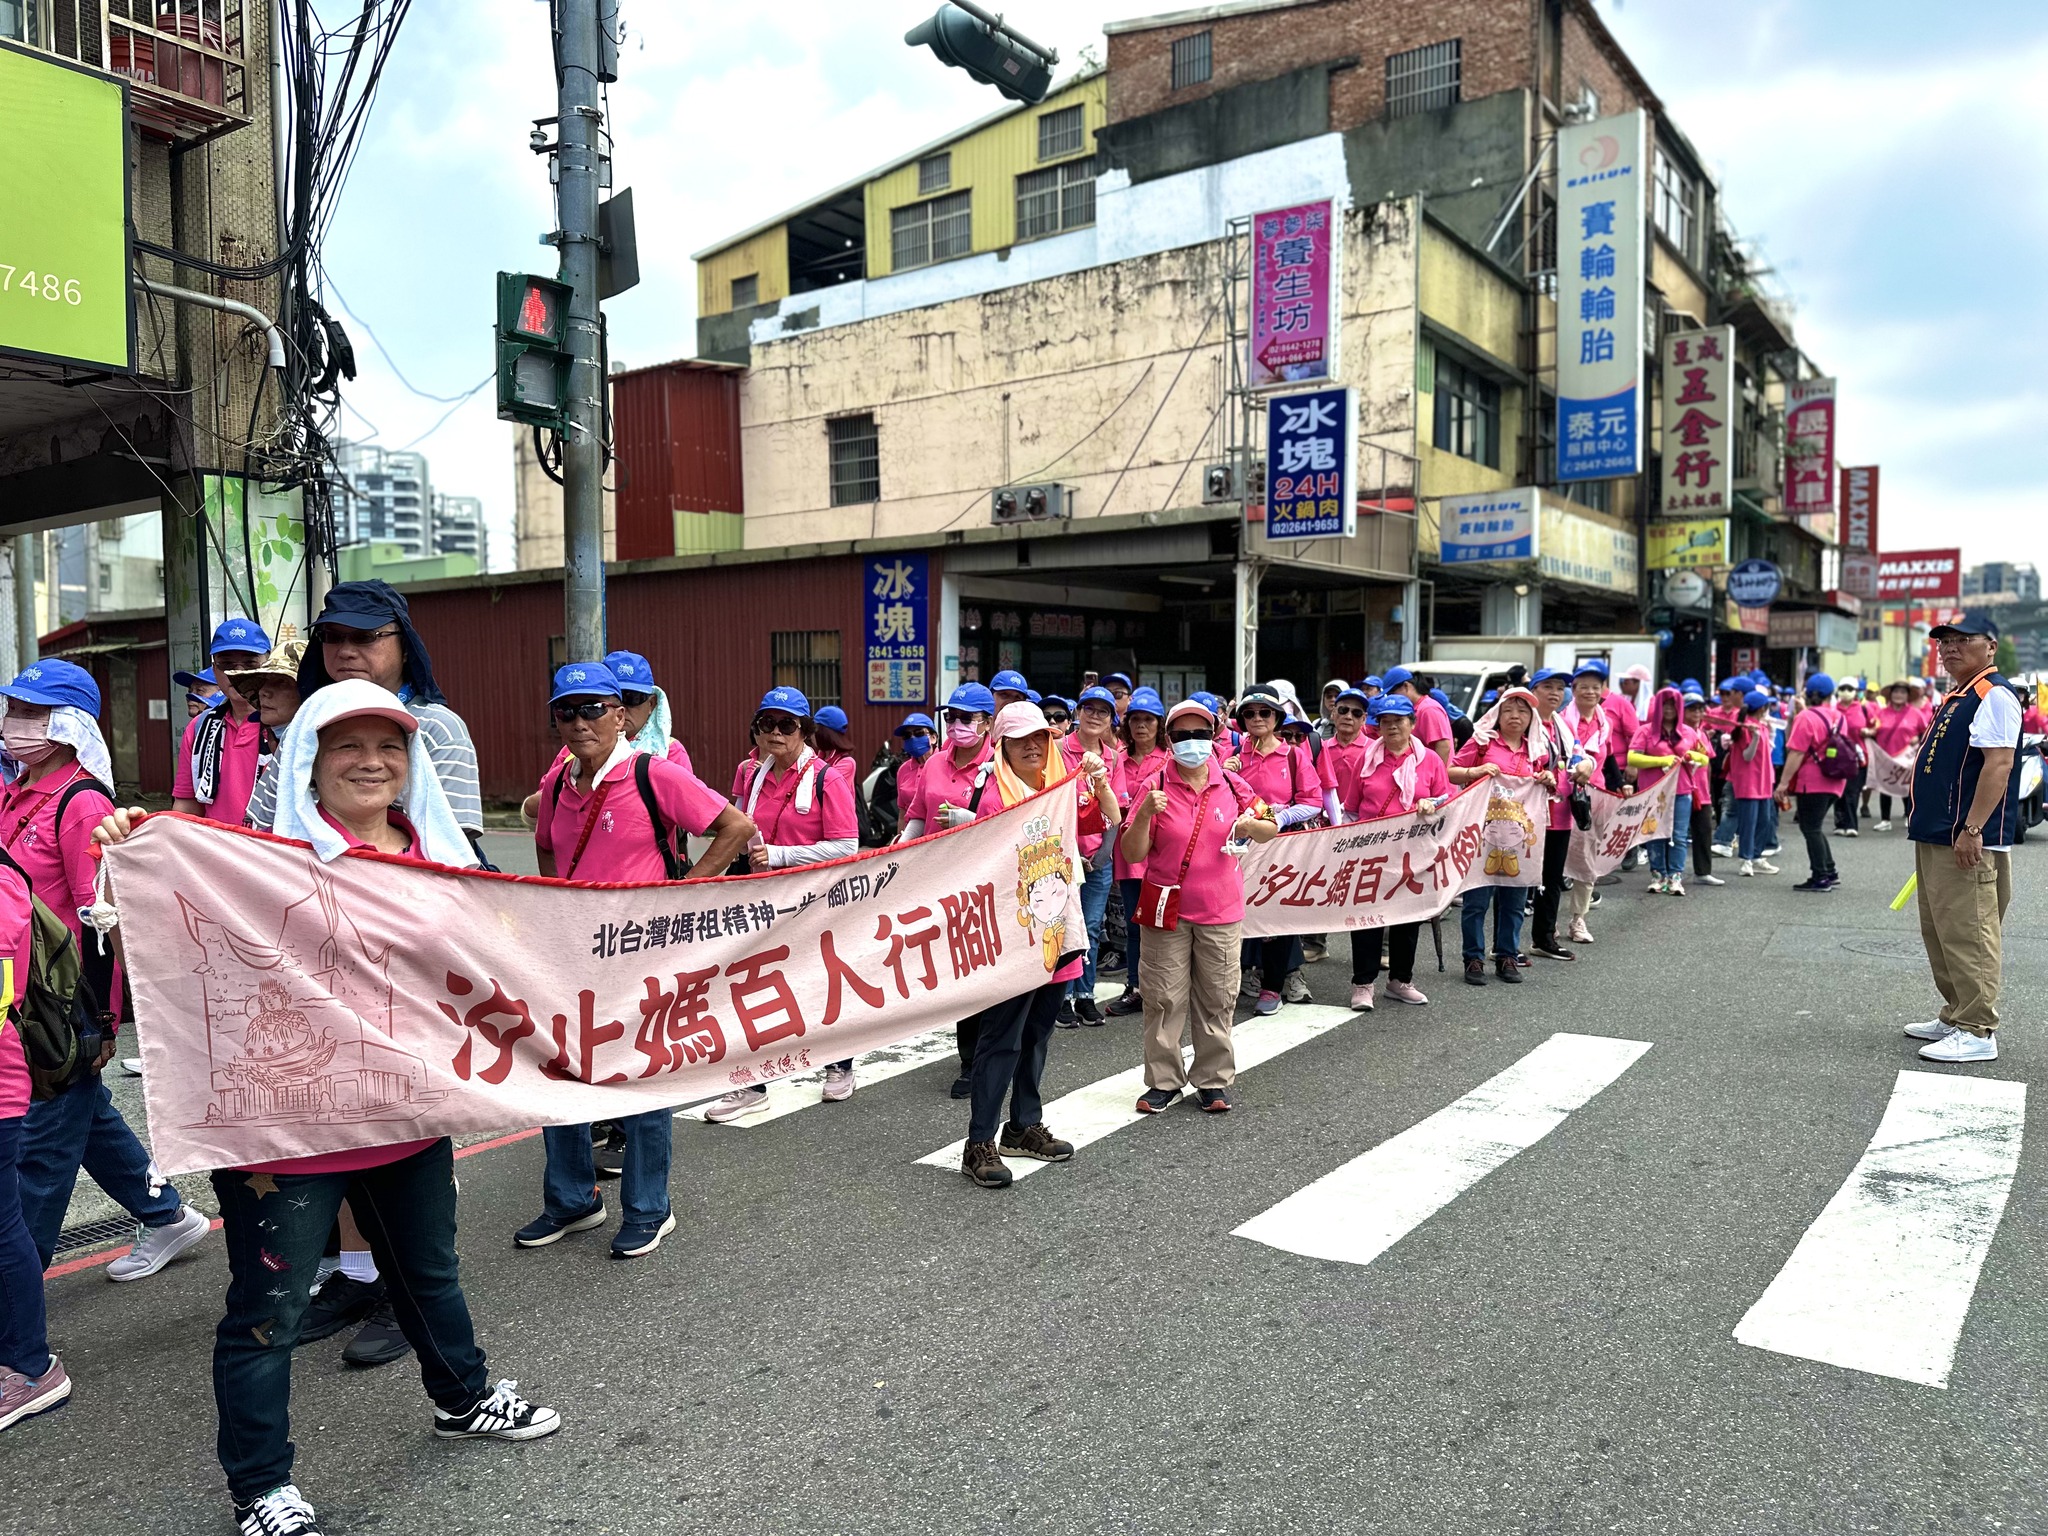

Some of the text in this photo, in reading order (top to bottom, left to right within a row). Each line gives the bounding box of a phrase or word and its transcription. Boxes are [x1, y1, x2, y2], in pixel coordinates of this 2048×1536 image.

[0, 264, 82, 306] 7486
[1272, 236, 1314, 334] 養生坊
[1580, 200, 1616, 366] 賽輪輪胎
[1278, 398, 1338, 474] 冰塊
[1670, 366, 1723, 489] 五金行
[1273, 498, 1339, 522] 火鍋肉
[1274, 471, 1339, 500] 24H
[1272, 518, 1339, 535] (02)2641-9658
[872, 559, 916, 643] 冰塊
[1879, 559, 1954, 575] MAXXIS
[868, 645, 925, 658] 2641-9658
[592, 874, 871, 959] 北台灣媽祖精神一步一腳印
[437, 882, 1002, 1086] 汐止媽百人行腳
